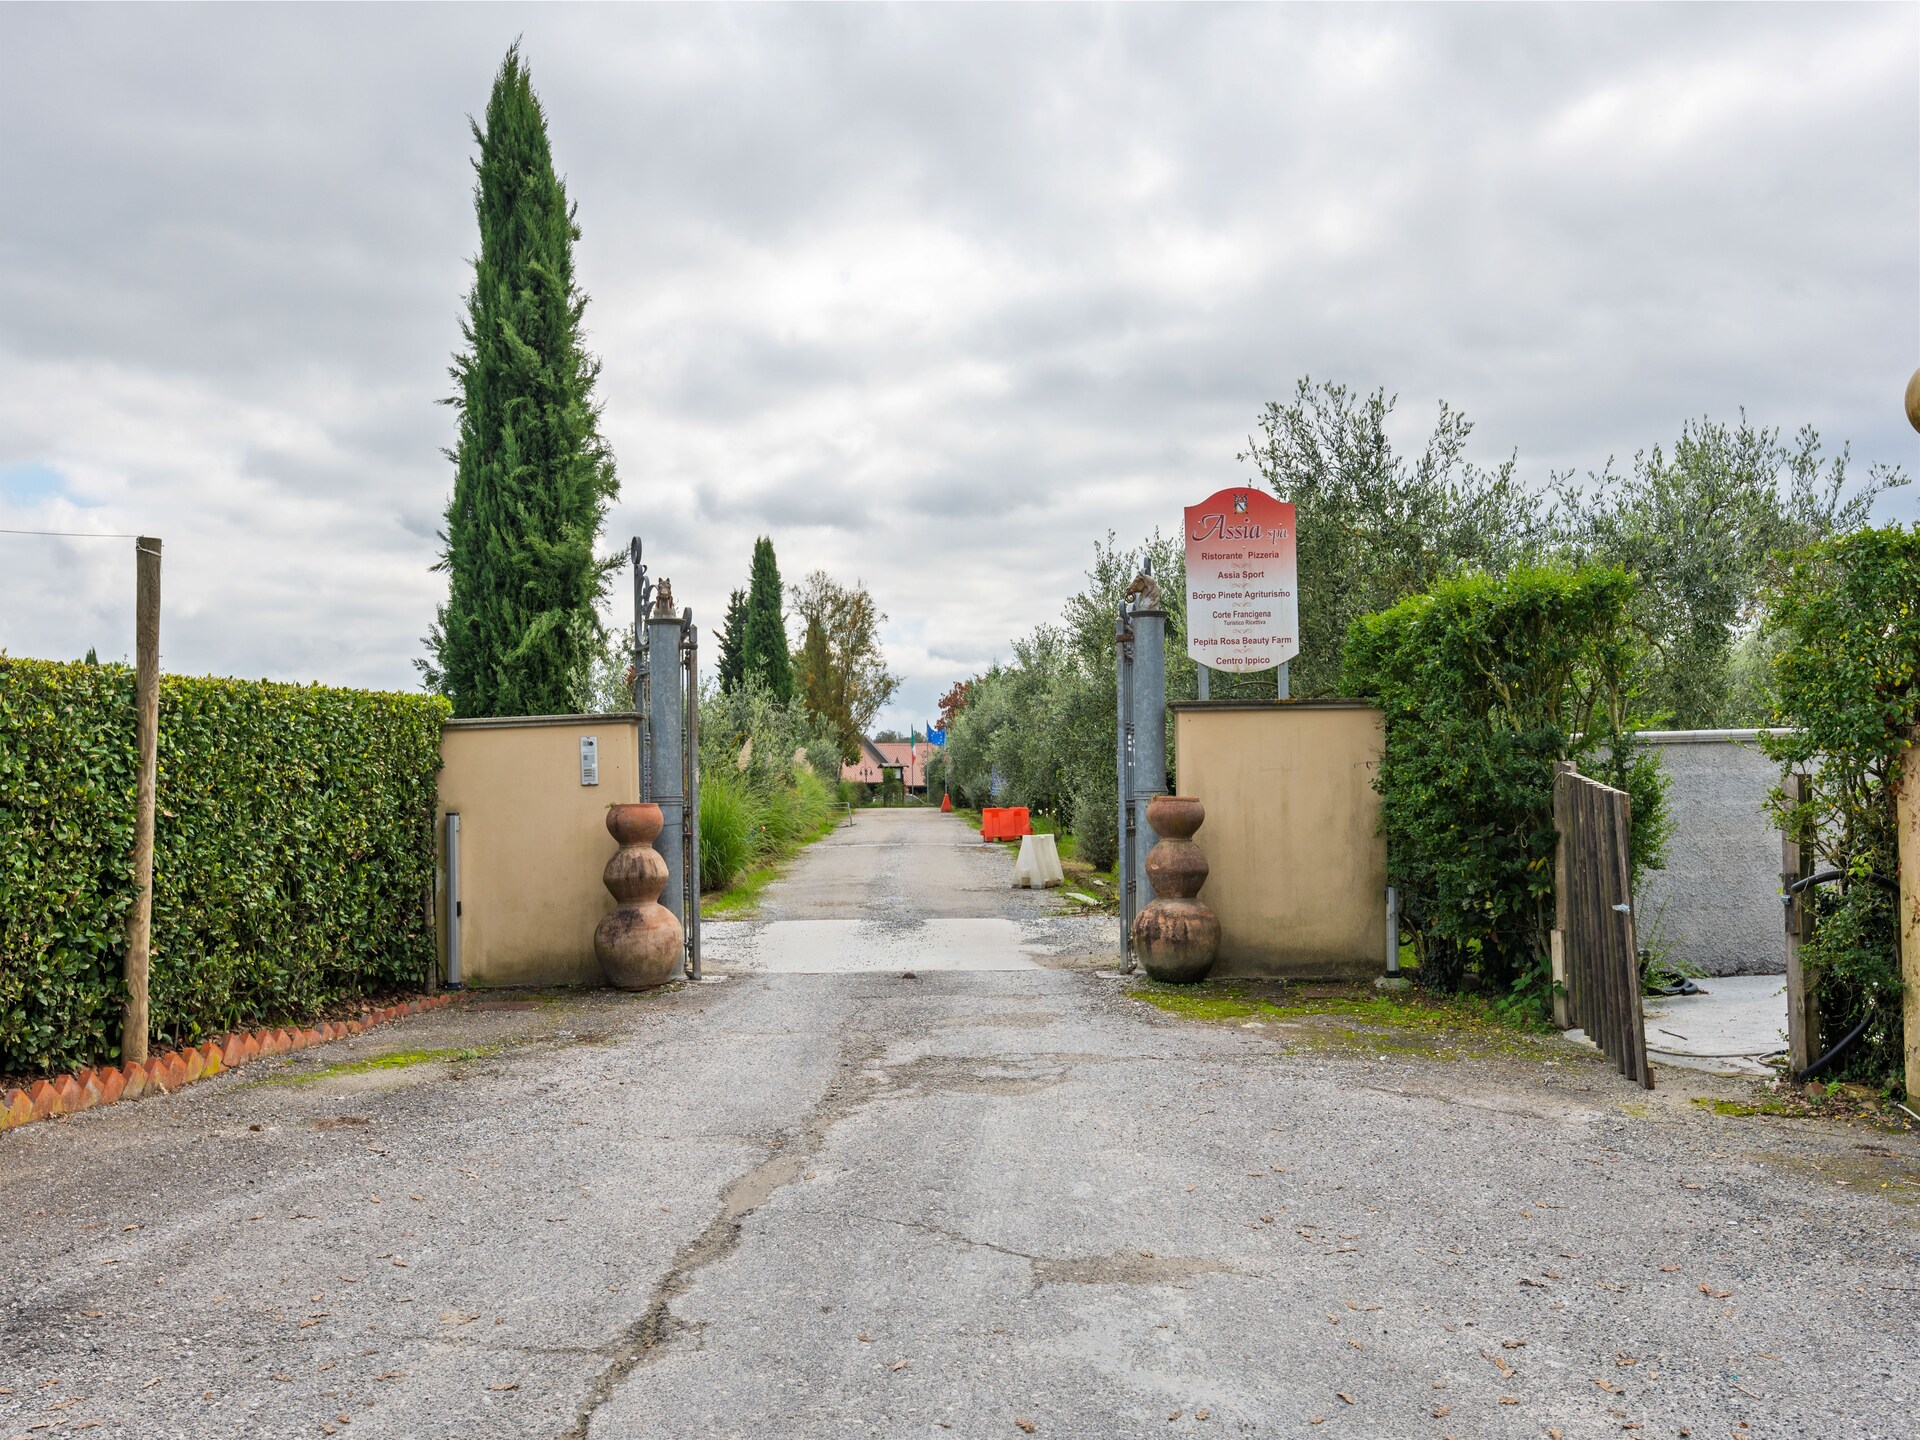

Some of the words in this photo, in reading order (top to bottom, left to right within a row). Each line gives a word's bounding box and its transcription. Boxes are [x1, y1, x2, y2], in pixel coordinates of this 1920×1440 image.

[1192, 514, 1262, 542] Assia
[1266, 528, 1288, 545] spa
[1201, 552, 1243, 560] Ristorante
[1248, 551, 1280, 560] Pizzeria
[1217, 571, 1241, 579] Assia
[1242, 570, 1265, 580] Sport
[1192, 591, 1217, 600] Borgo
[1218, 591, 1243, 599] Pinete
[1244, 590, 1291, 600] Agriturismo
[1212, 610, 1232, 619] Corte
[1233, 610, 1272, 619] Francigena
[1193, 638, 1218, 647] Pepita
[1220, 637, 1241, 645] Rosa
[1242, 637, 1270, 646] Beauty
[1271, 636, 1292, 644] Farm
[1216, 657, 1243, 665] Centro
[1245, 656, 1270, 666] Ippico
